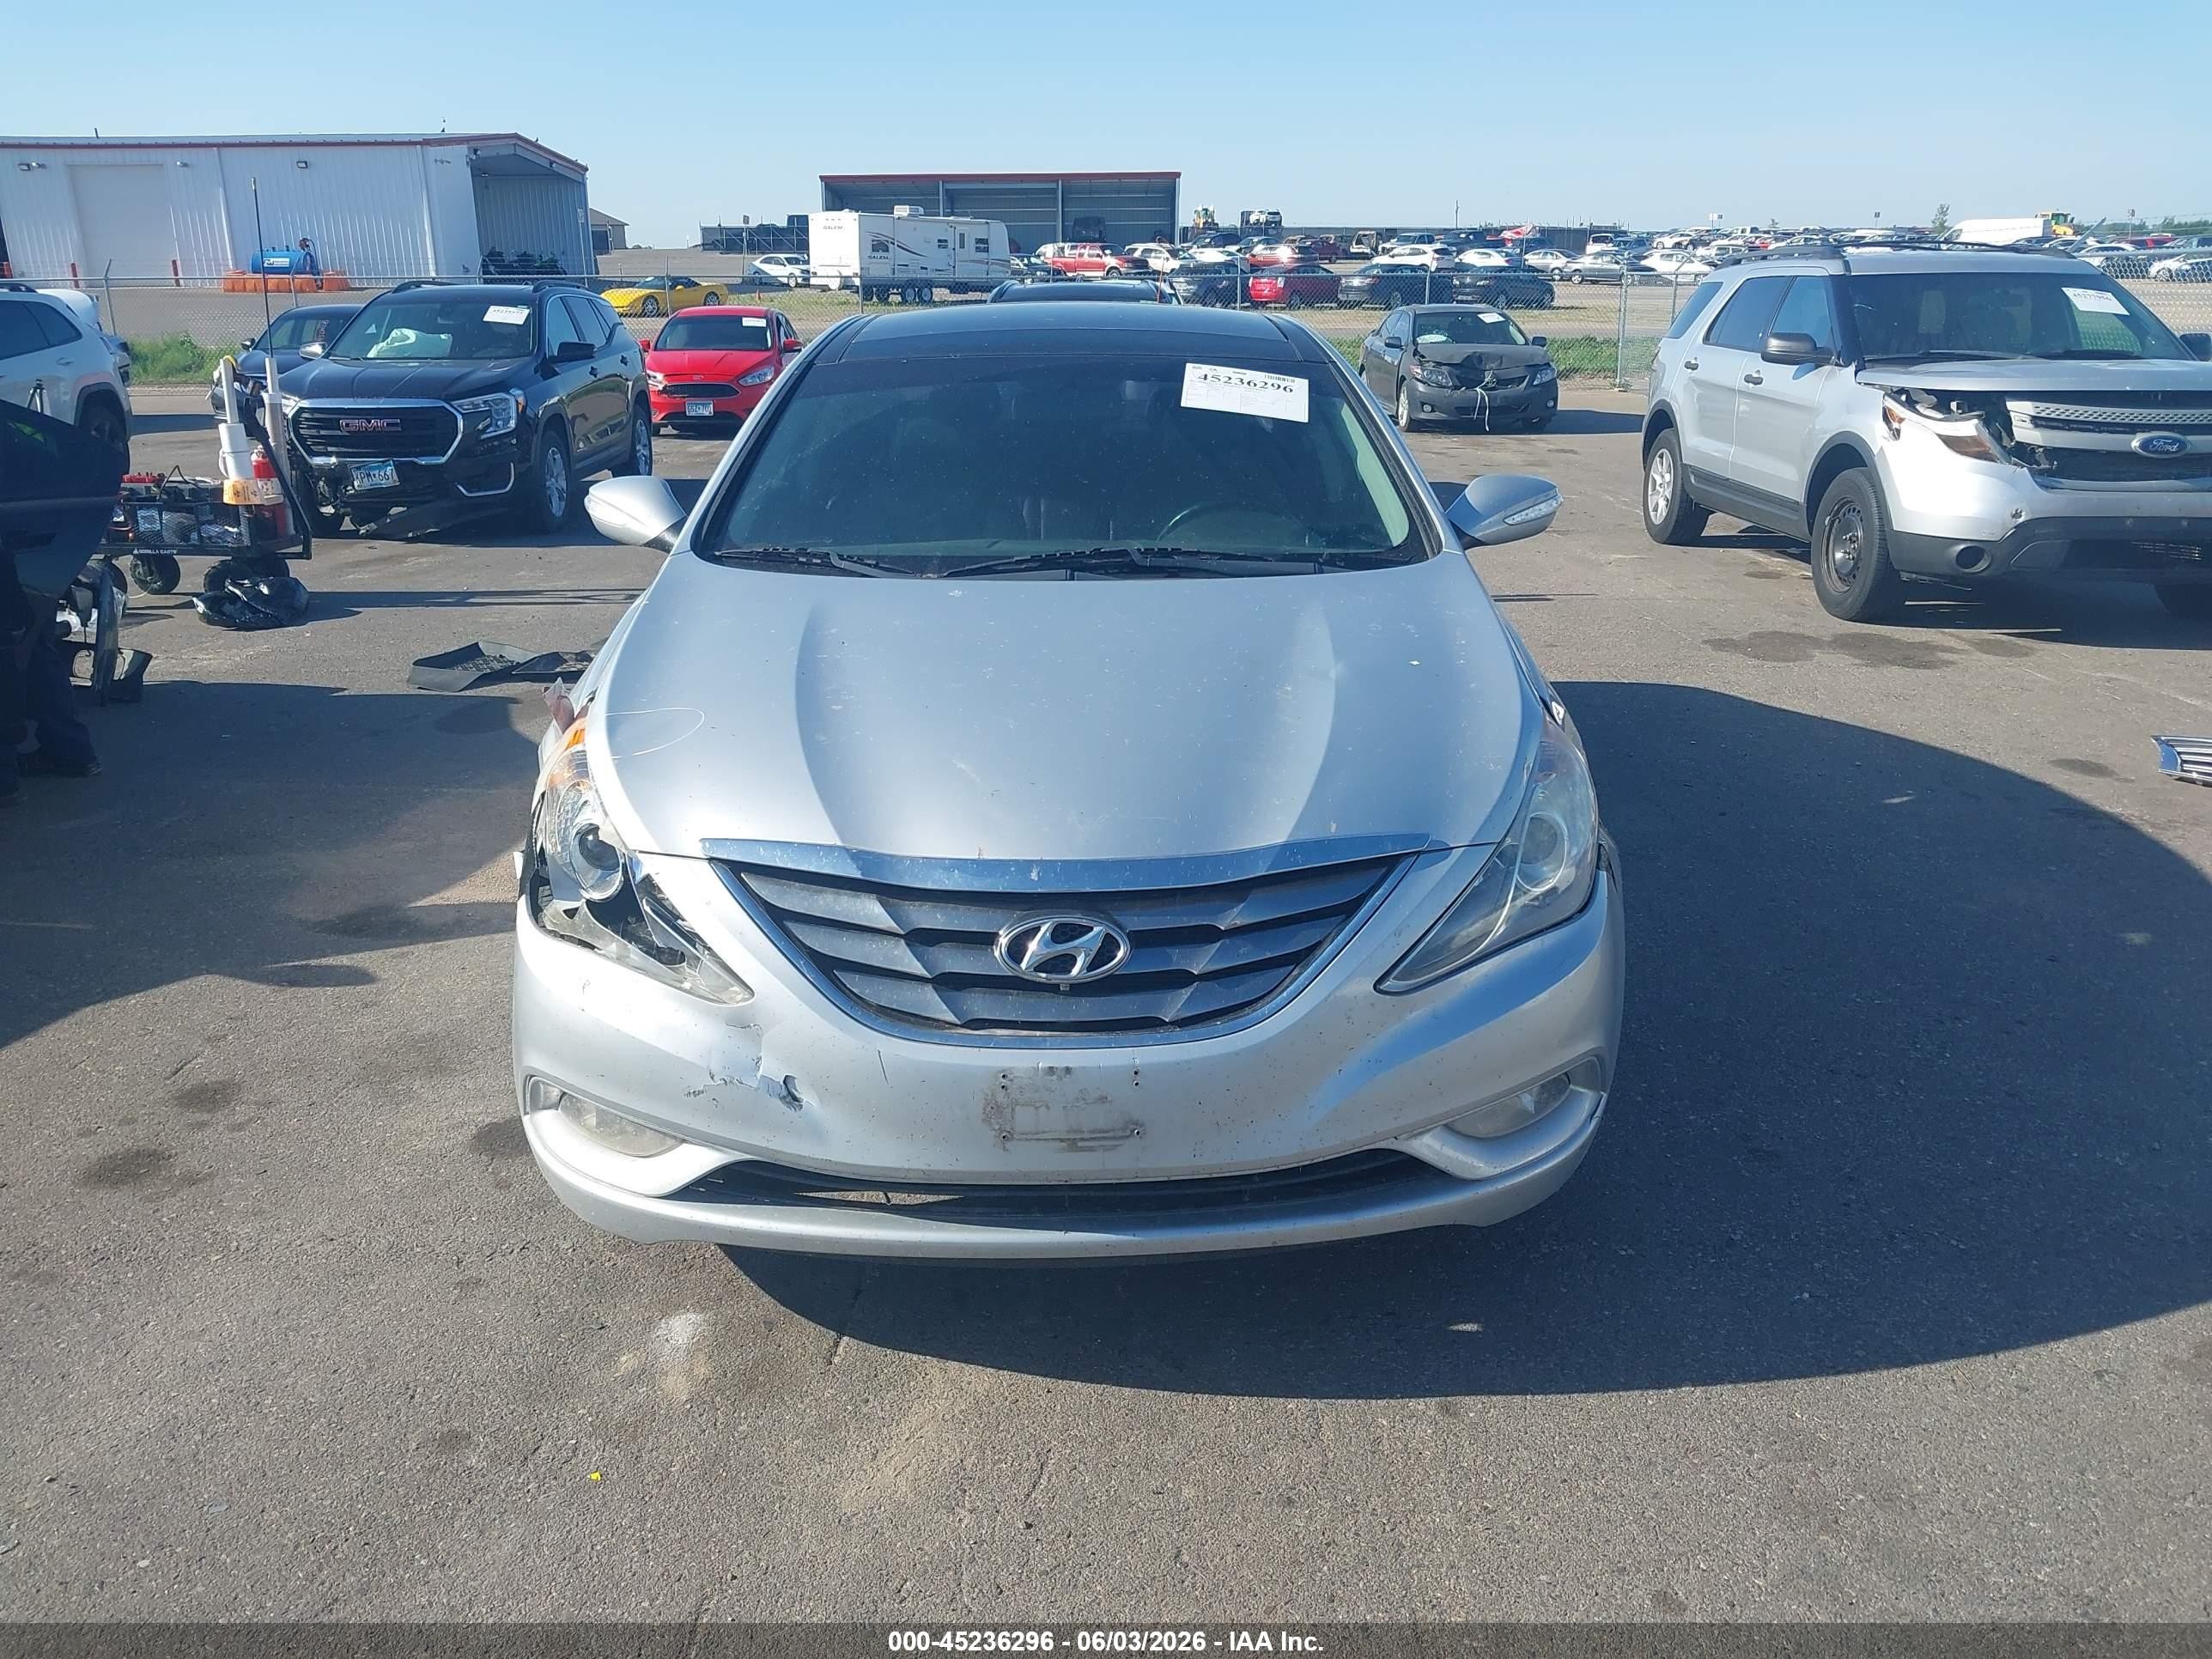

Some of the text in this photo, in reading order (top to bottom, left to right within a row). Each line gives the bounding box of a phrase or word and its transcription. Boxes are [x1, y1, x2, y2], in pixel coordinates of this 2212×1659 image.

[1198, 373, 1294, 393] 45236296
[340, 418, 401, 431] GMC
[2149, 438, 2180, 452] Ford
